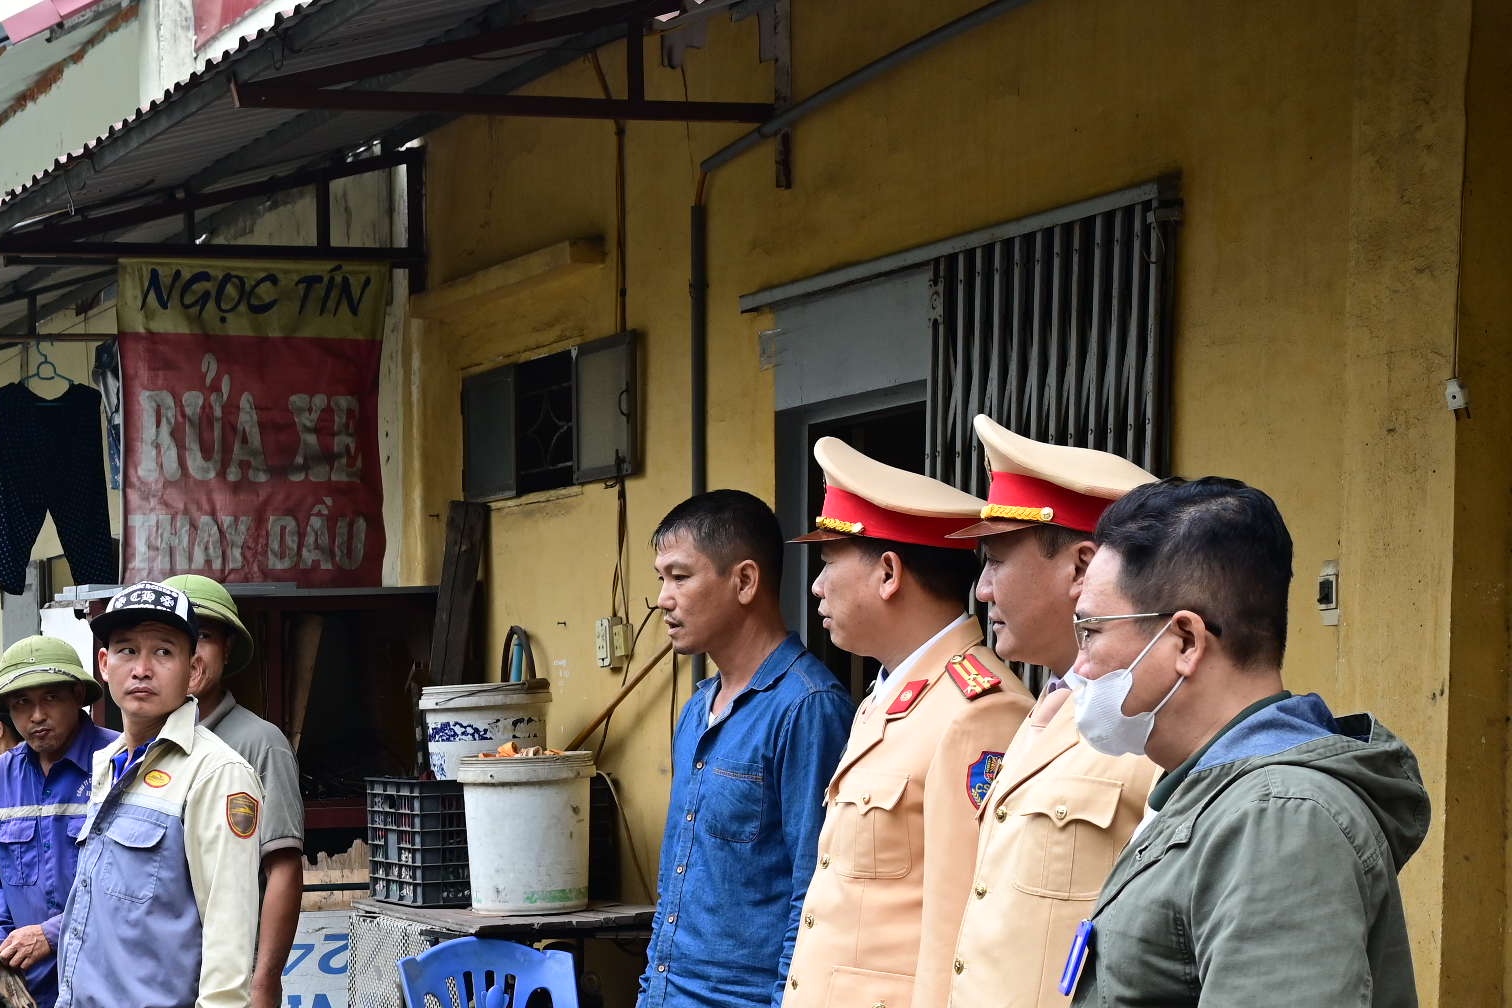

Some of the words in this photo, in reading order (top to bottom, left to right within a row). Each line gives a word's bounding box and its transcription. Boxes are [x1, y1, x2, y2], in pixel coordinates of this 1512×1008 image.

[140, 267, 279, 324] NGỌC
[294, 263, 372, 317] TÍN
[136, 352, 272, 483] RỬA
[288, 393, 363, 483] XE
[128, 514, 250, 570] THAY
[267, 496, 367, 571] DẦU
